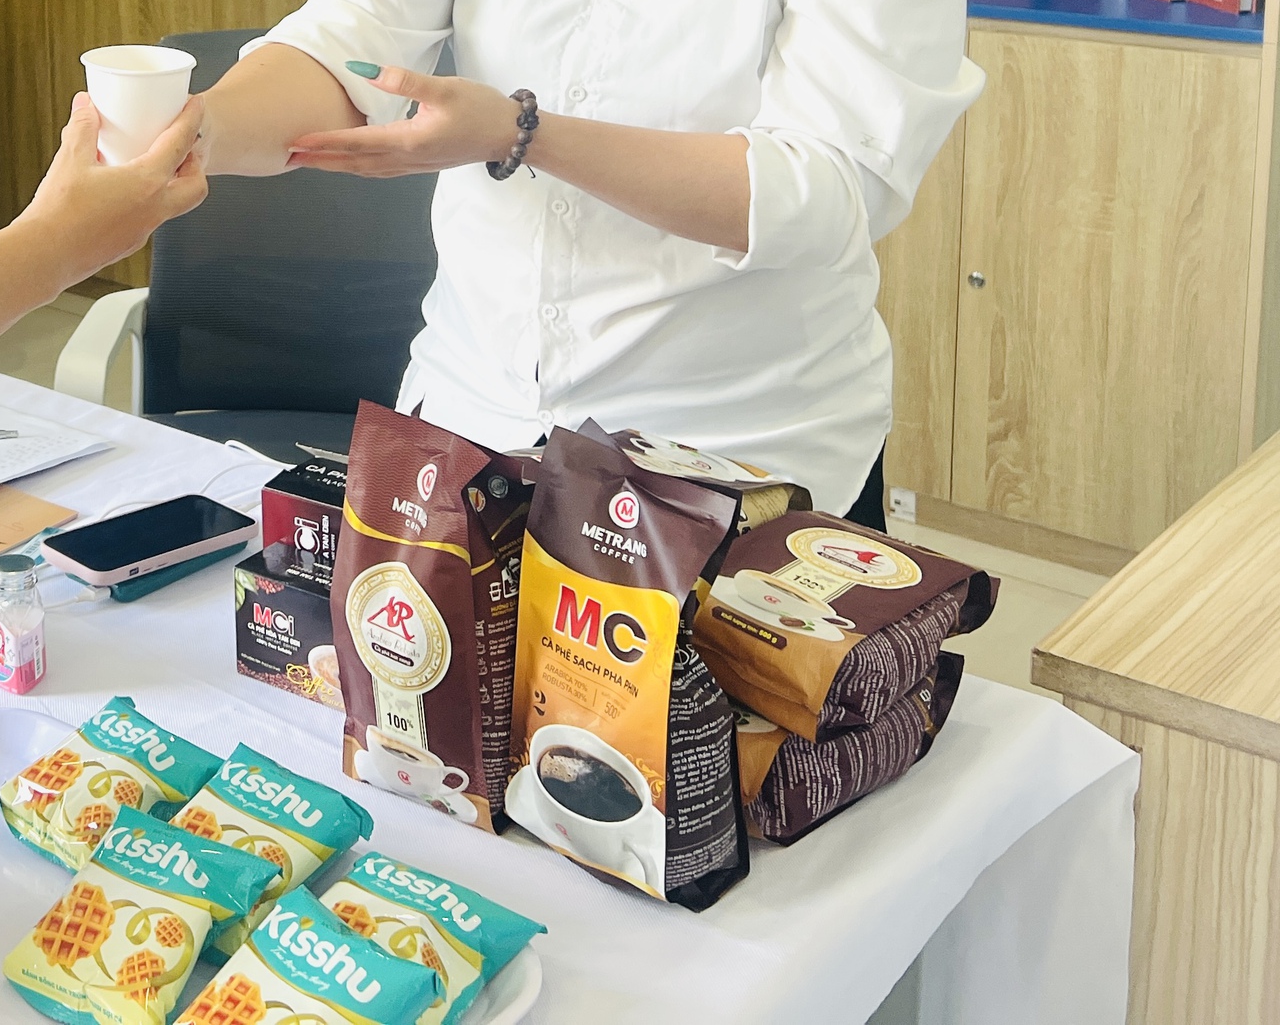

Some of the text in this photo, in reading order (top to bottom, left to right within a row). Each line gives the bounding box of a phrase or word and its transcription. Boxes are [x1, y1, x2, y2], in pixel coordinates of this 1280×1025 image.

[581, 521, 647, 558] METRANG
[593, 543, 636, 565] COFFEE
[554, 583, 649, 665] MC
[758, 629, 772, 641] 500
[286, 663, 335, 696] Coffee
[541, 636, 639, 698] CÀ PHÊ SẠCH PHA PHIN
[542, 672, 573, 694] ROBUSTA
[544, 663, 574, 684] ARABICA
[387, 712, 413, 731] 100%
[91, 710, 175, 771] Kisshu
[221, 760, 323, 828] Kisshu
[105, 827, 210, 888] Kisshu
[364, 858, 482, 932] Kisshu
[258, 905, 381, 1003] Kisshu
[22, 968, 38, 980] BÁNH
